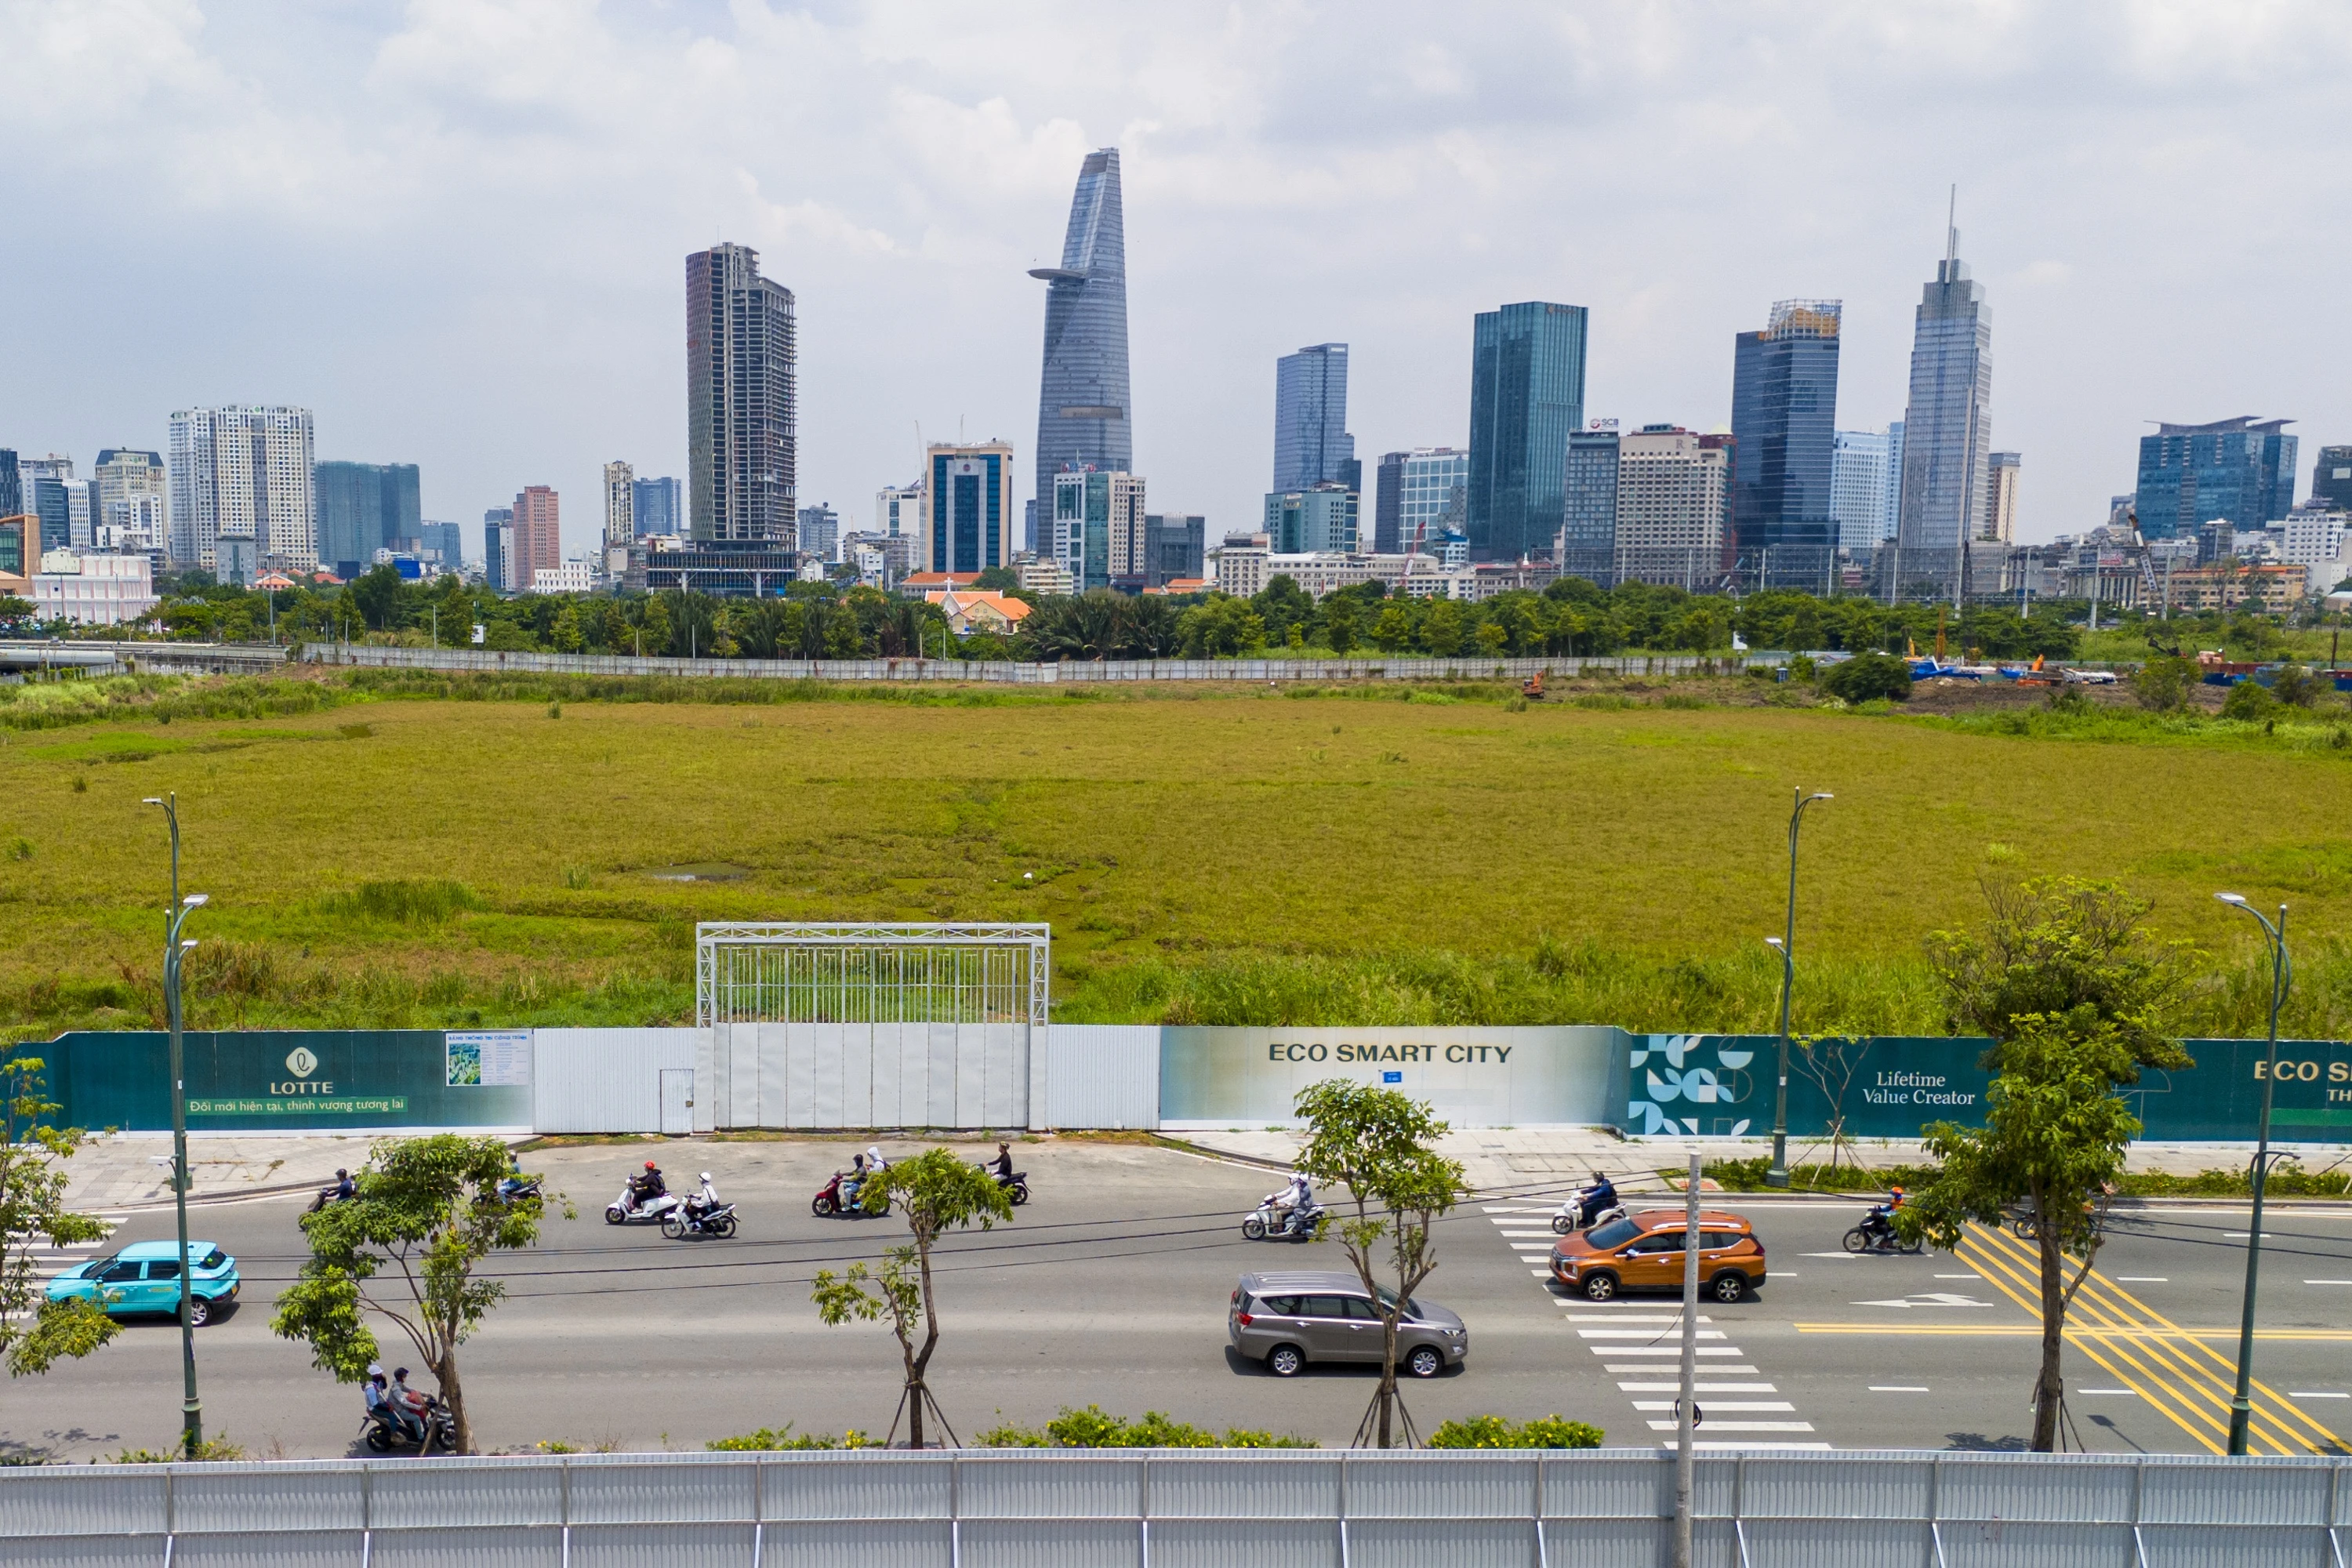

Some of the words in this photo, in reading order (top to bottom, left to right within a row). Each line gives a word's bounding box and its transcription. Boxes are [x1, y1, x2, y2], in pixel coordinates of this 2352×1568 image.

[1601, 418, 1619, 426] SCB
[1269, 1044, 1328, 1062] ECO
[1336, 1044, 1438, 1062] SMART
[1445, 1044, 1512, 1063] CITY
[1877, 1071, 1946, 1087] Lifetime
[2254, 1060, 2319, 1081] ECO
[2328, 1062, 2352, 1082] S
[270, 1081, 334, 1094] LOTTE
[1862, 1088, 1908, 1104] Value
[1913, 1089, 1976, 1105] Creator
[215, 1101, 236, 1112] mới
[239, 1101, 263, 1113] hiện
[287, 1100, 315, 1112] thịnh
[319, 1101, 353, 1112] vượng
[356, 1101, 389, 1112] tương
[392, 1098, 404, 1109] lai
